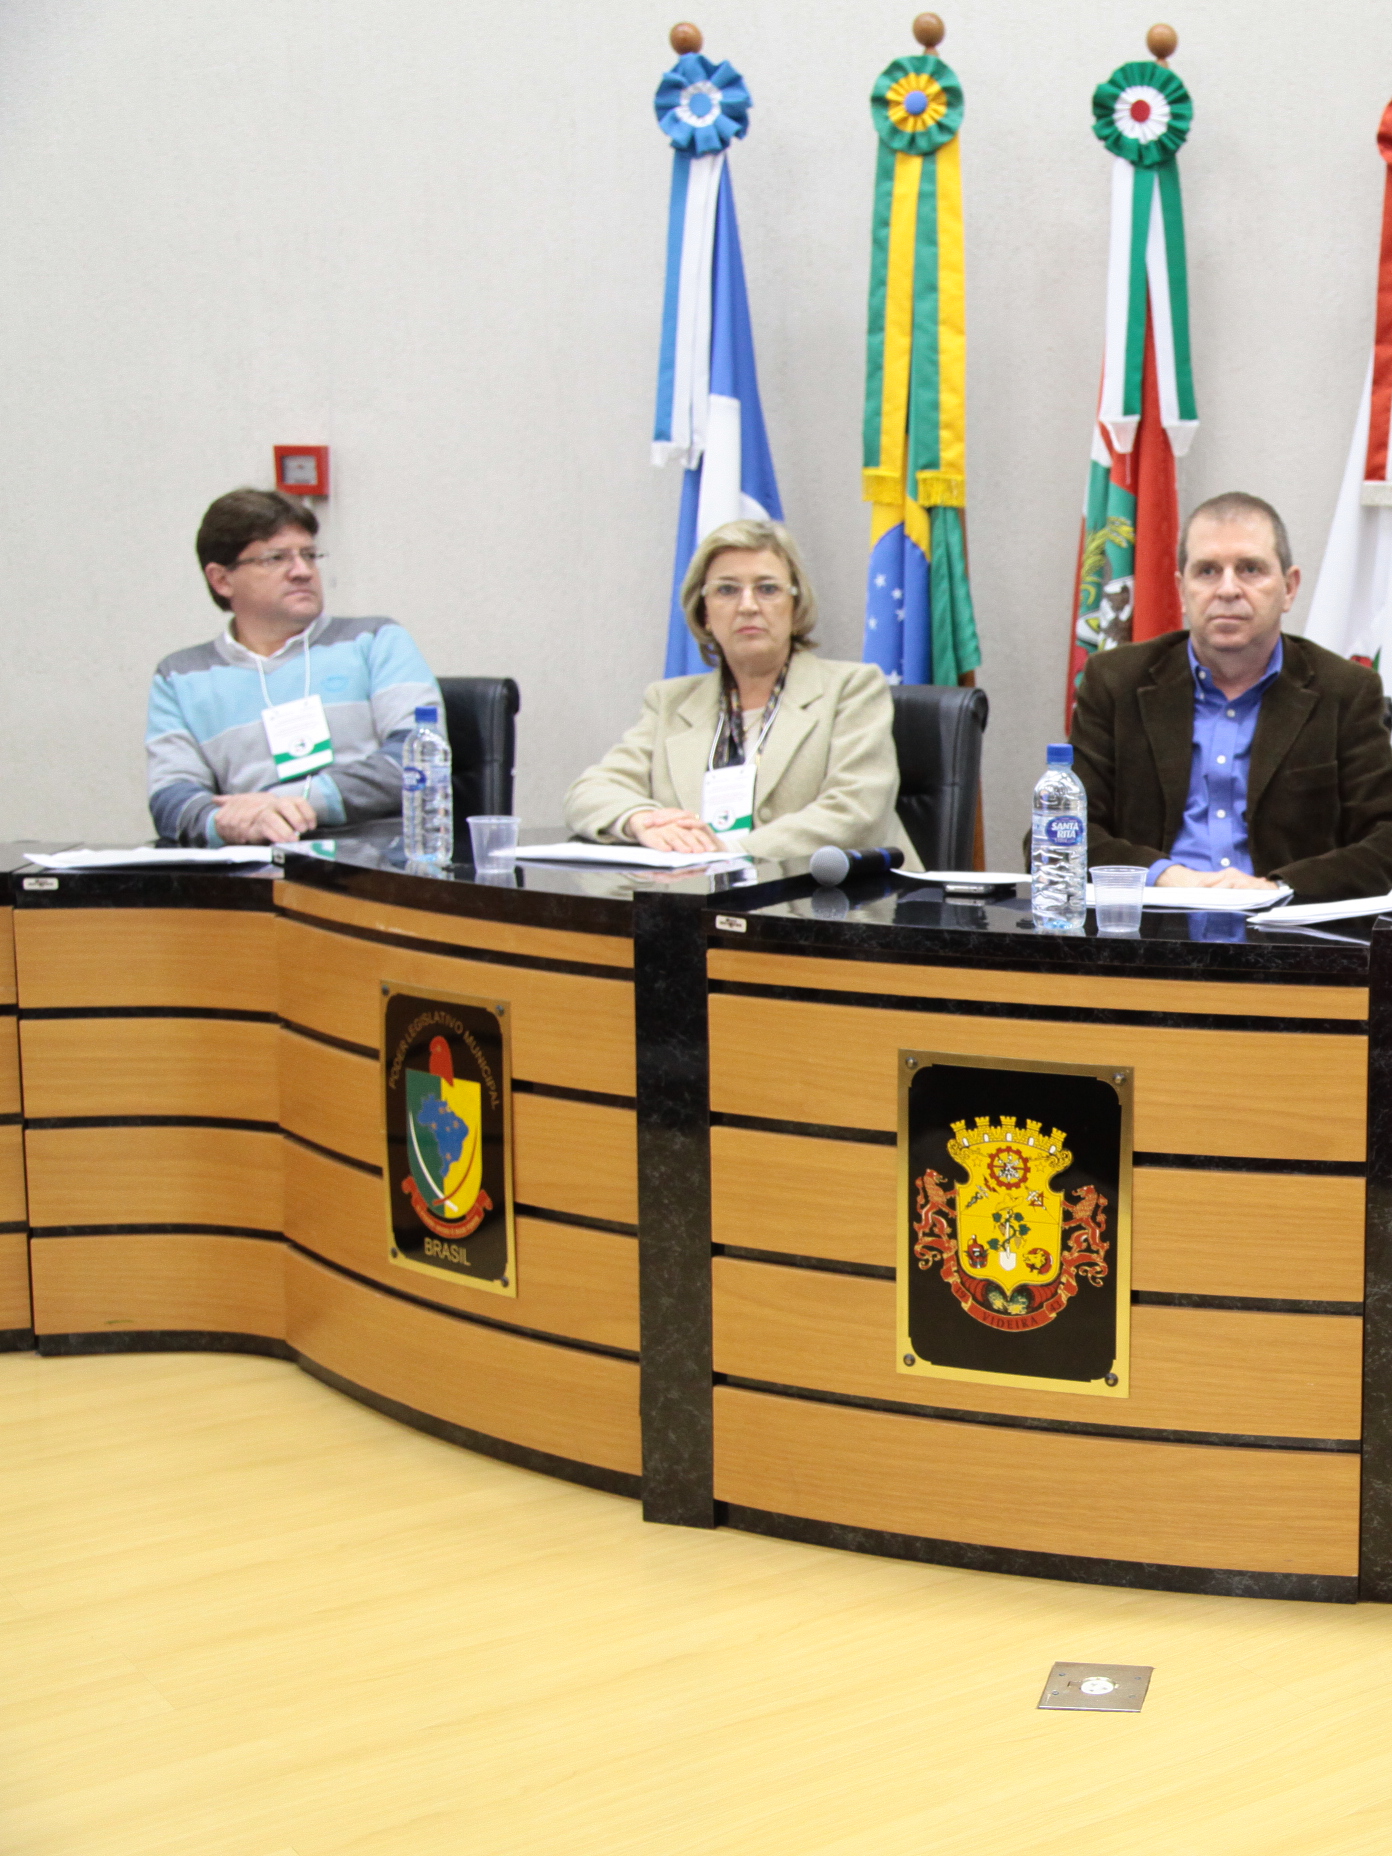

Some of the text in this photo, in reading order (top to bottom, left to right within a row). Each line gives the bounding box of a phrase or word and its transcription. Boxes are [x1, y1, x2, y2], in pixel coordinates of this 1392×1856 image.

[1051, 822, 1079, 831] SANTA
[1057, 830, 1076, 838] RITA
[388, 1011, 499, 1110] PODER LEGISLATIVO MUNICIPAL
[424, 1237, 471, 1266] BRASIL
[982, 1312, 1038, 1330] VIDEIRA
